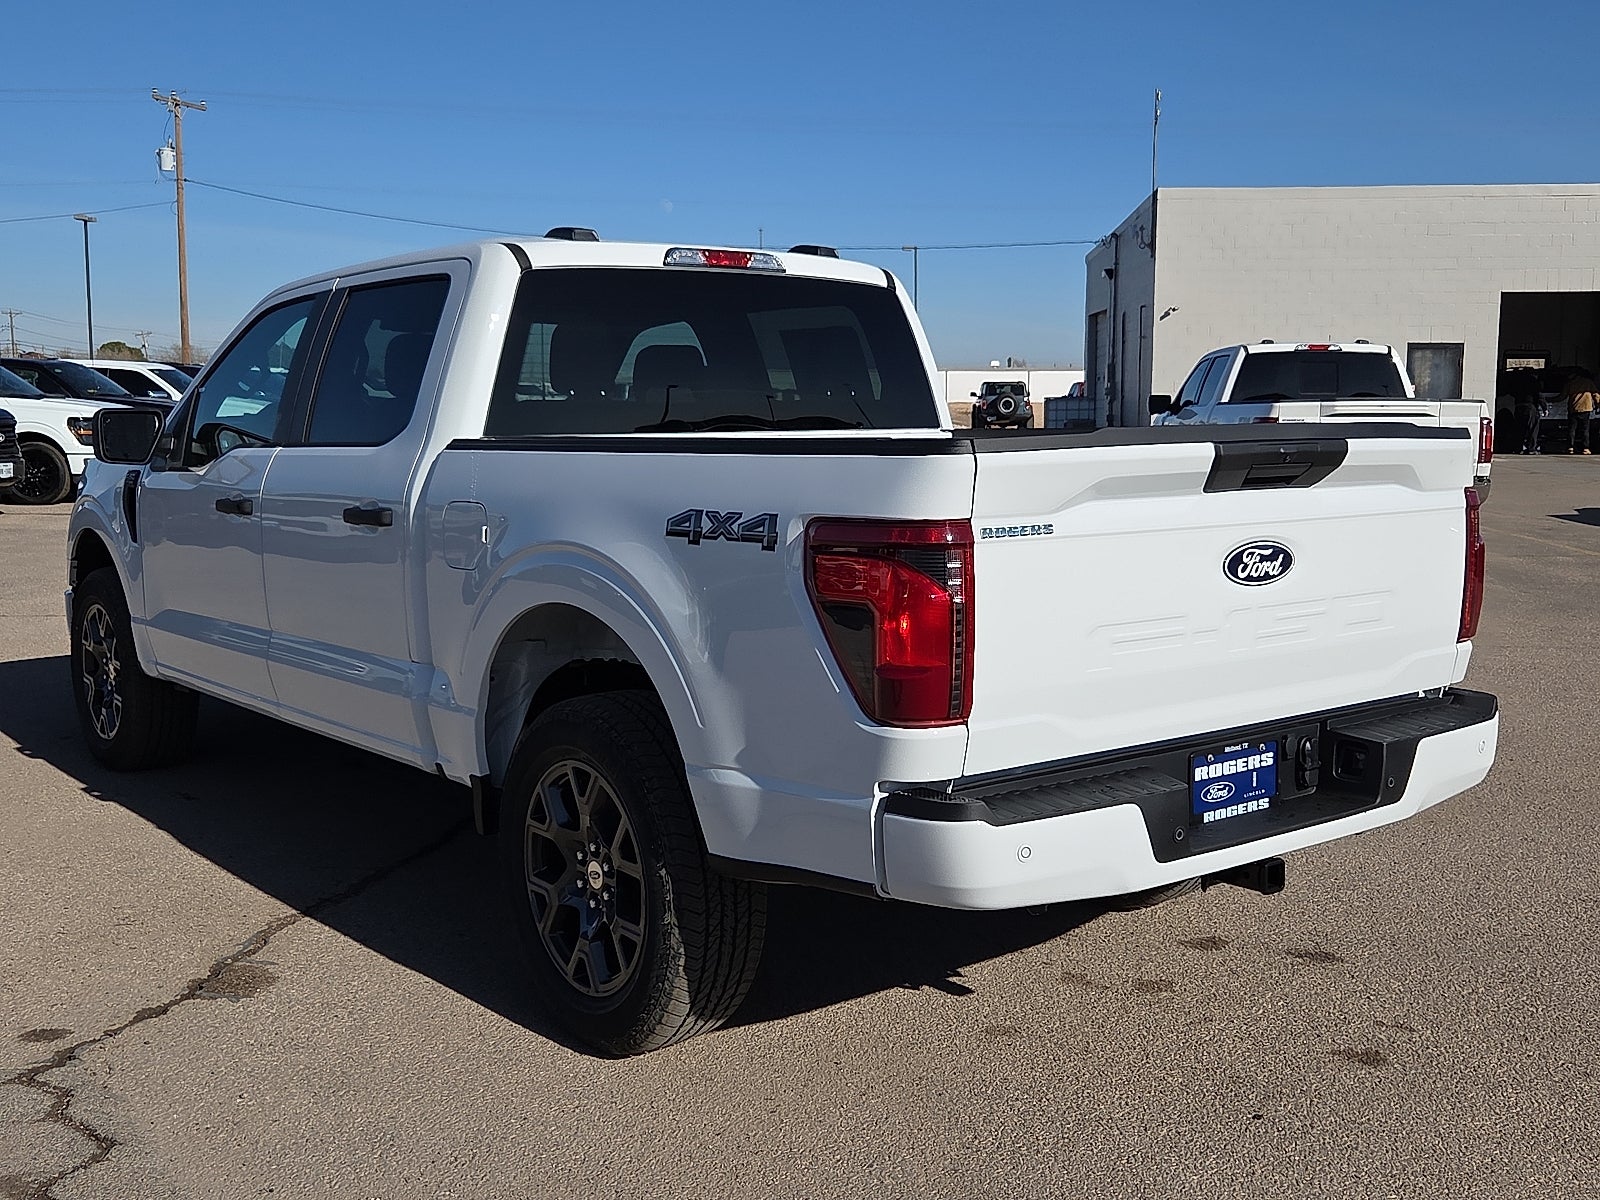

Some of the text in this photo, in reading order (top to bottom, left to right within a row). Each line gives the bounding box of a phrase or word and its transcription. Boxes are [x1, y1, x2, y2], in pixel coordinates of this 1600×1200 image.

[980, 524, 1054, 541] ROGERS
[1233, 545, 1287, 581] Ford
[1194, 752, 1274, 782] ROGERS
[1205, 783, 1231, 801] Ford
[1203, 797, 1270, 824] ROGERS
